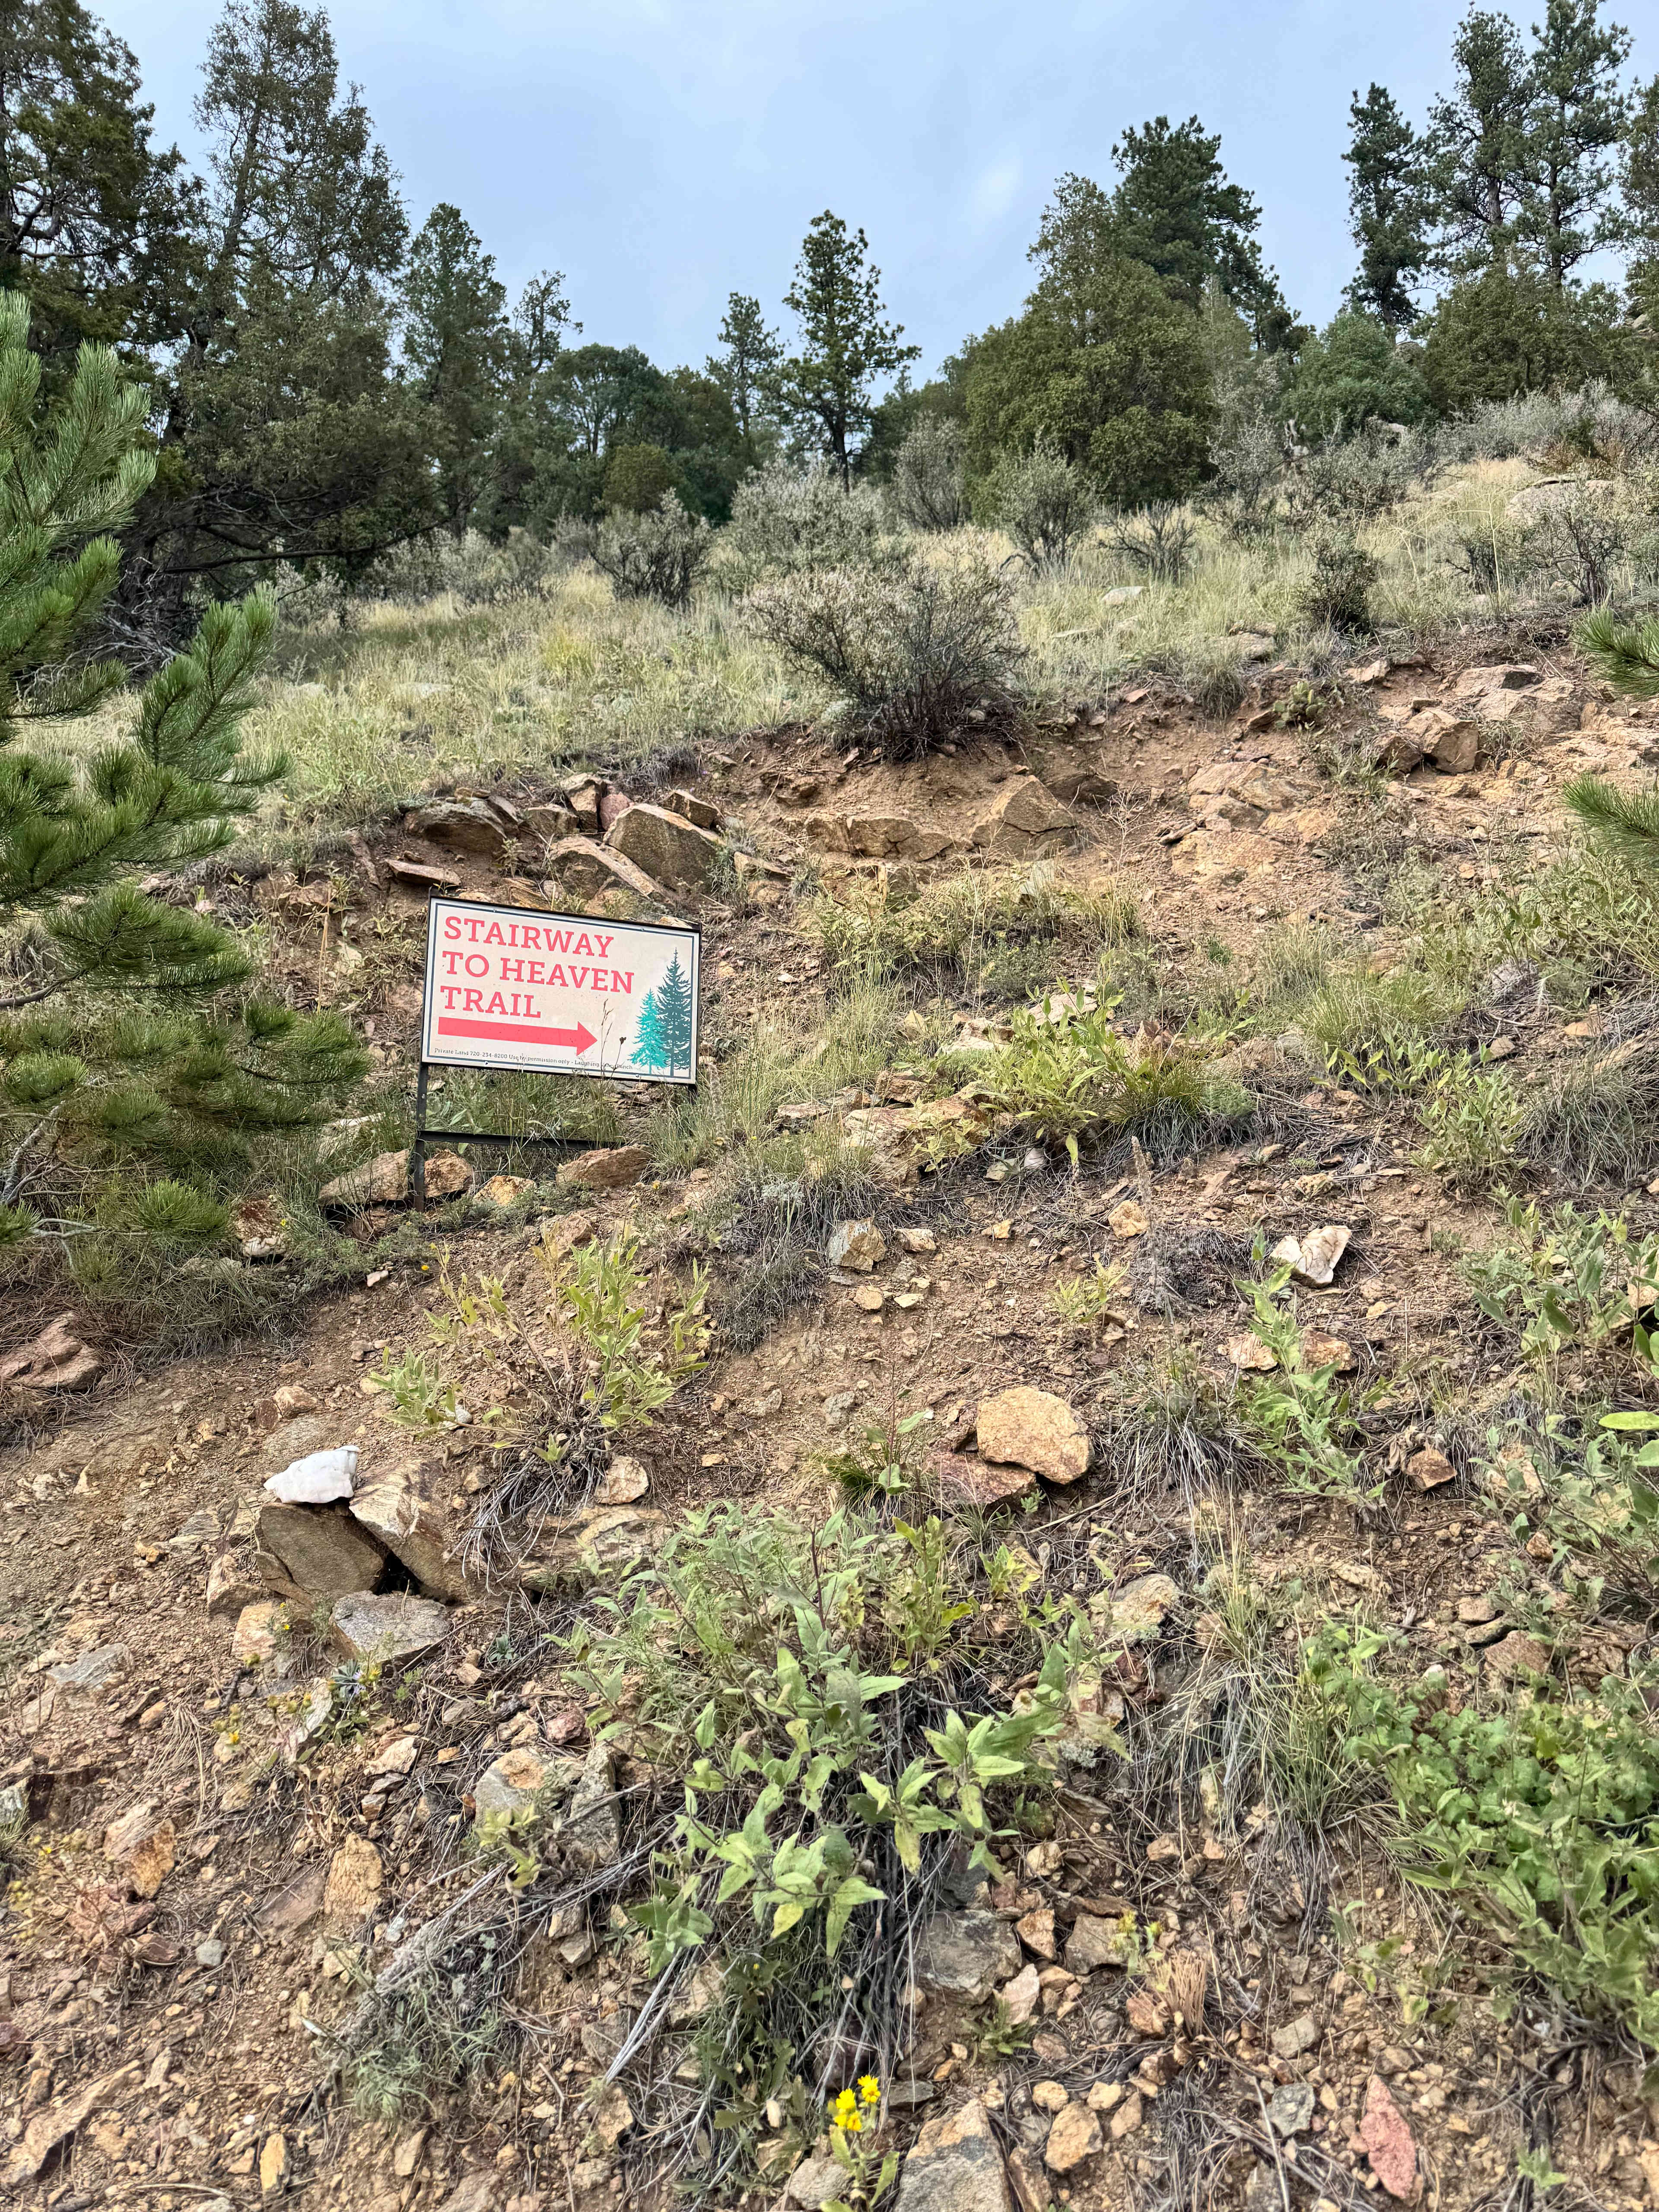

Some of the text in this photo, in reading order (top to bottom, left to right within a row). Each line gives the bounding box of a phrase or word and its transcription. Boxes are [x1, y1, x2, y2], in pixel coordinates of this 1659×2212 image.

[444, 916, 614, 958] STAIRWAY
[442, 951, 634, 994] TO HEAVEN
[440, 985, 541, 1018] TRAIL
[470, 1050, 508, 1059] 720-234-8200
